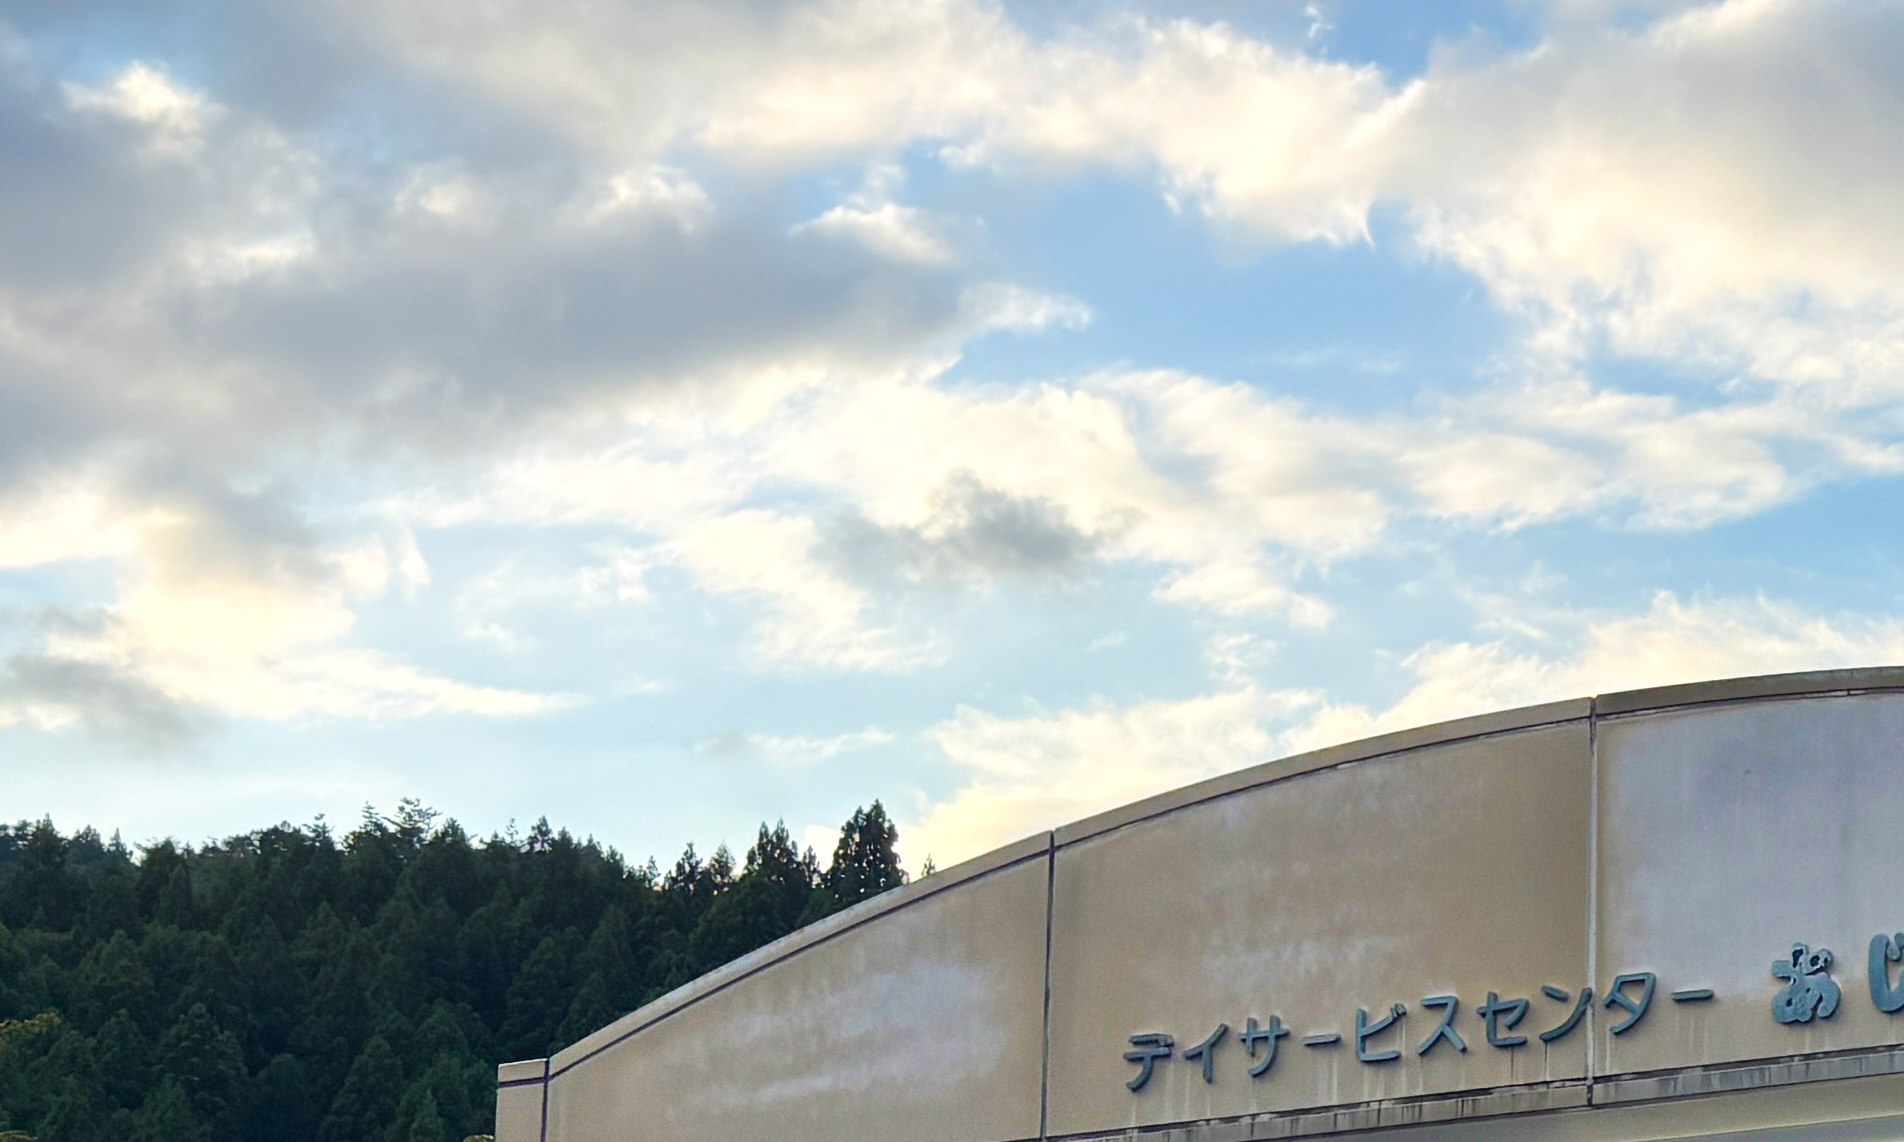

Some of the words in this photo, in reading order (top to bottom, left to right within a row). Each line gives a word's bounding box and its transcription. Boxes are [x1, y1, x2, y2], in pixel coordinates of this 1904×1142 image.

[1122, 971, 1715, 1093] デイサービスセンター
